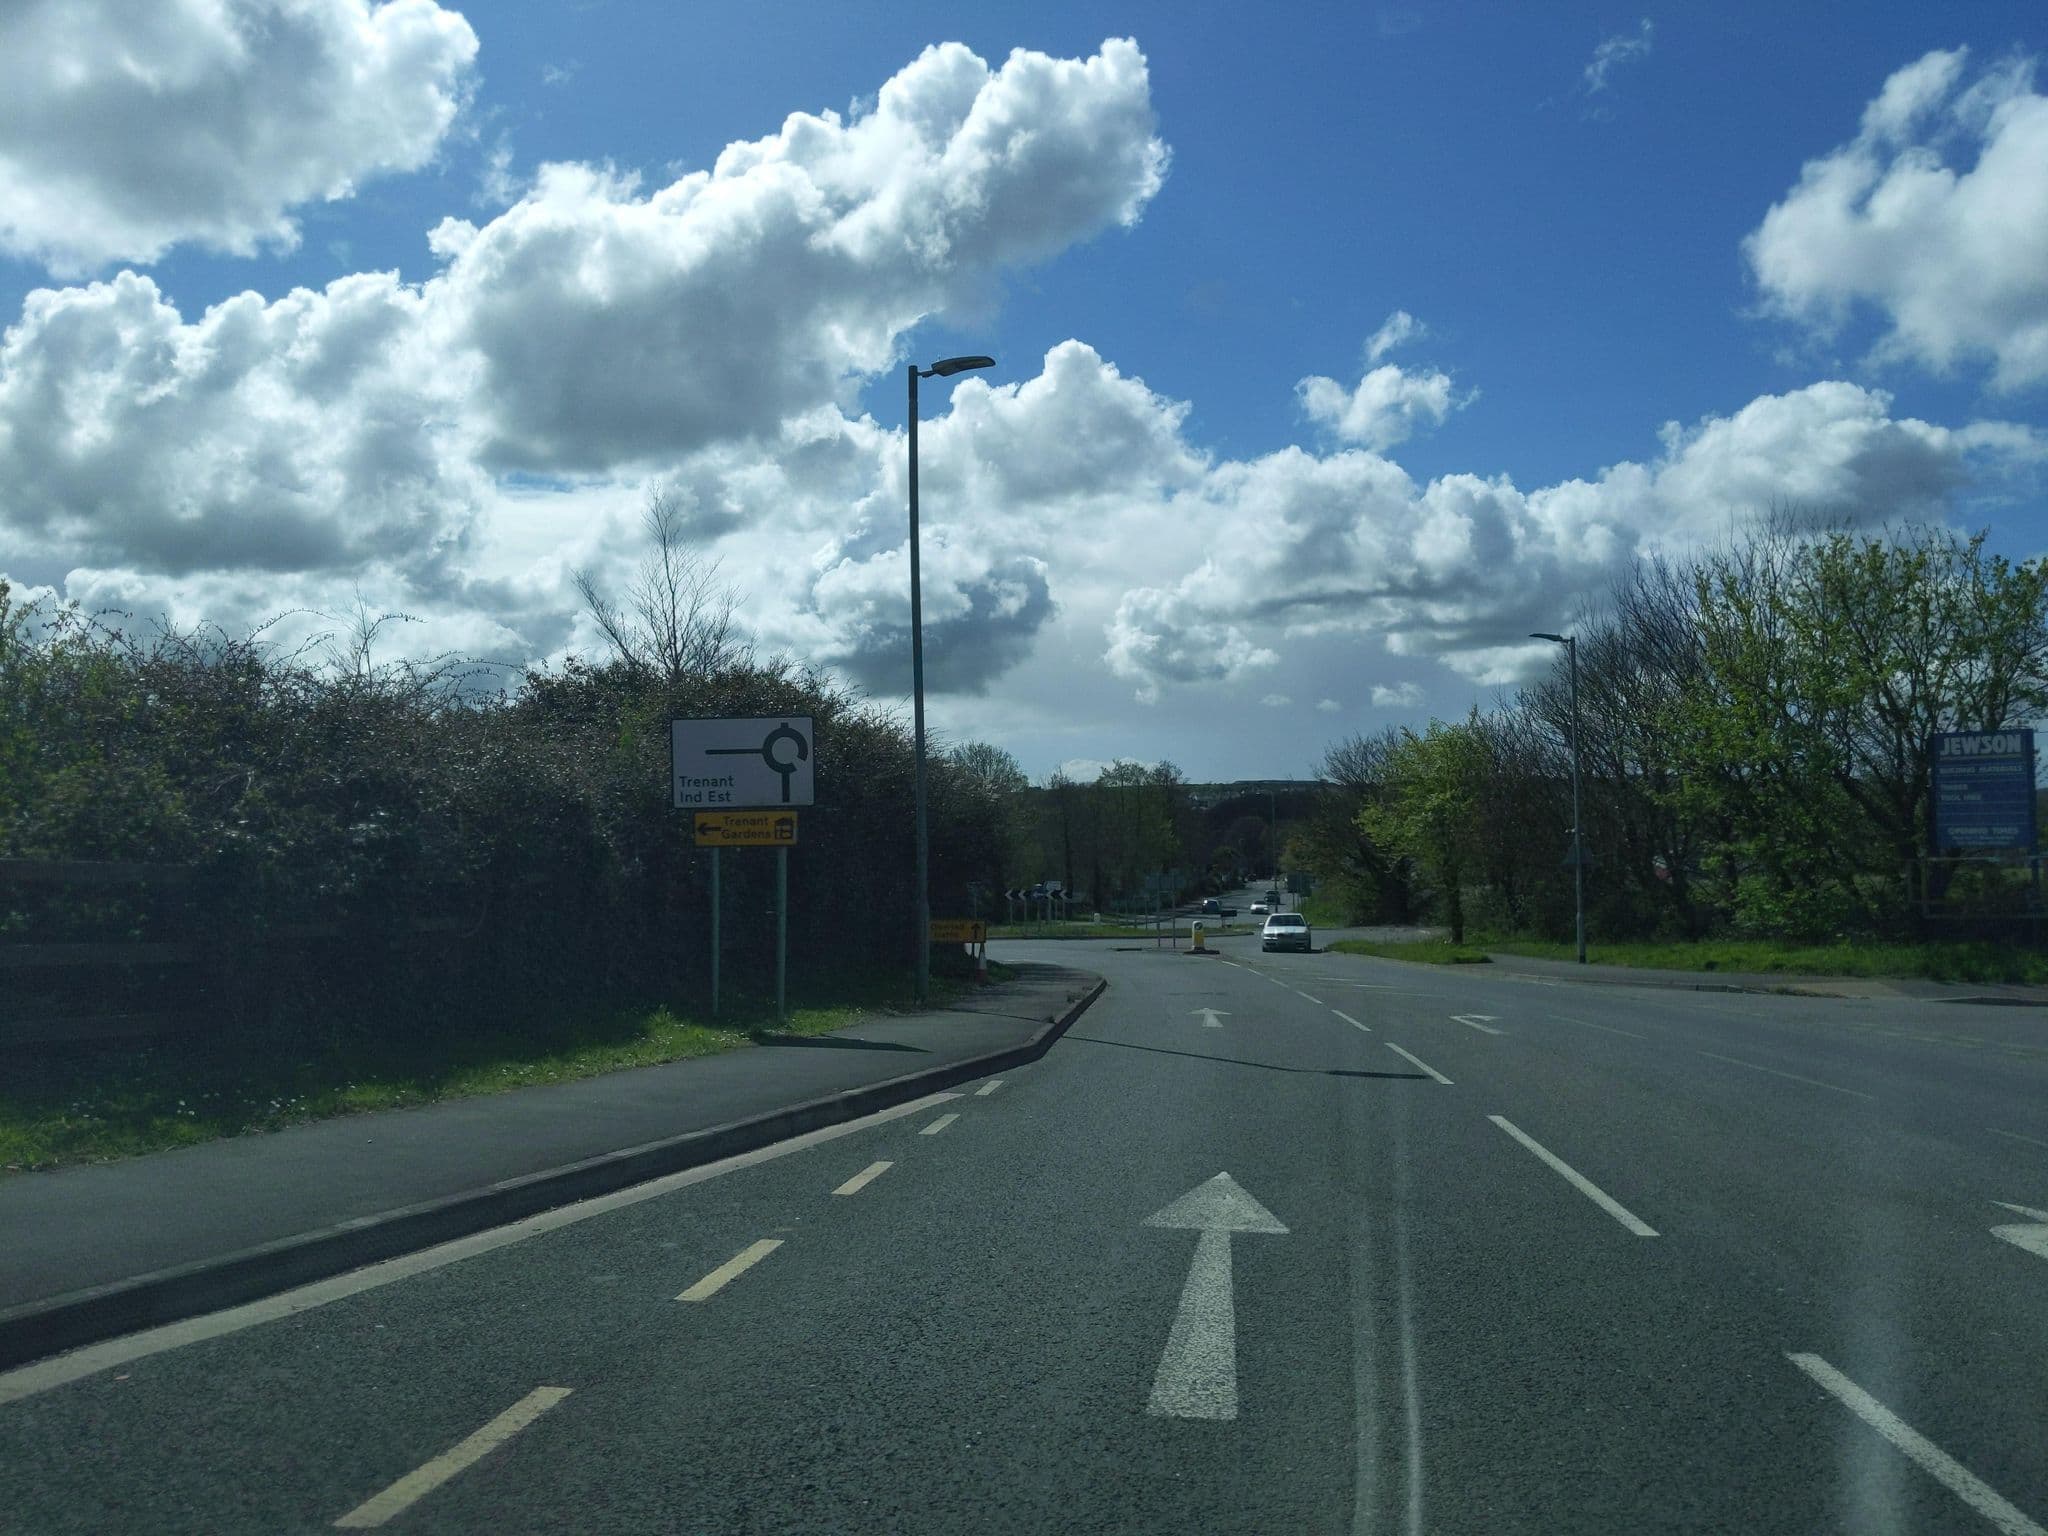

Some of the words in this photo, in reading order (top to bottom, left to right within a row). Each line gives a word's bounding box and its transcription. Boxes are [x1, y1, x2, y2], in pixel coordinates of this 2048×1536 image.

[1939, 734, 2022, 756] JEWSON
[679, 775, 735, 788] Trenant
[680, 791, 702, 803] Ind
[708, 790, 732, 803] Est
[723, 815, 769, 827] Trenant
[721, 828, 771, 839] Gardens
